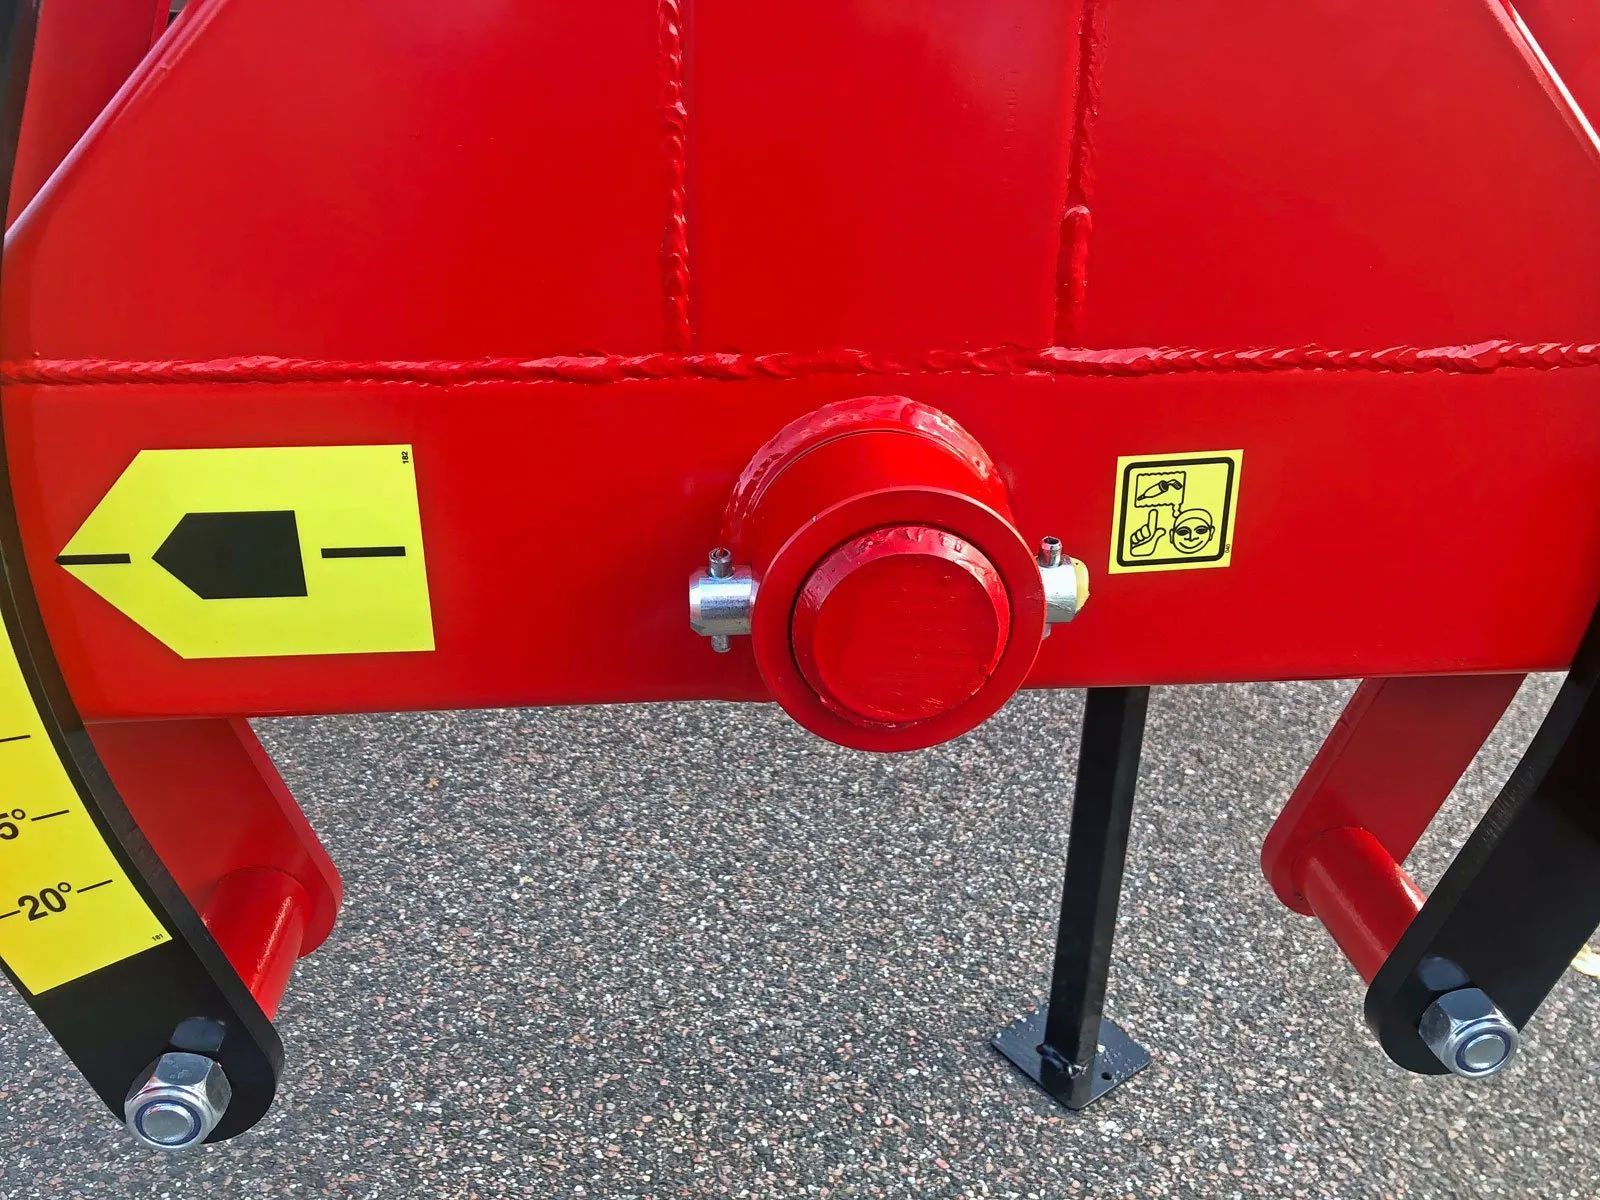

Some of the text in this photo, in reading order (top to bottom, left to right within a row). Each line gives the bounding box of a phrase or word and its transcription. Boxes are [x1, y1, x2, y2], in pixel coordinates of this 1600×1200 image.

[401, 451, 409, 464] 182
[18, 882, 72, 921] 20°
[152, 933, 164, 942] 181
